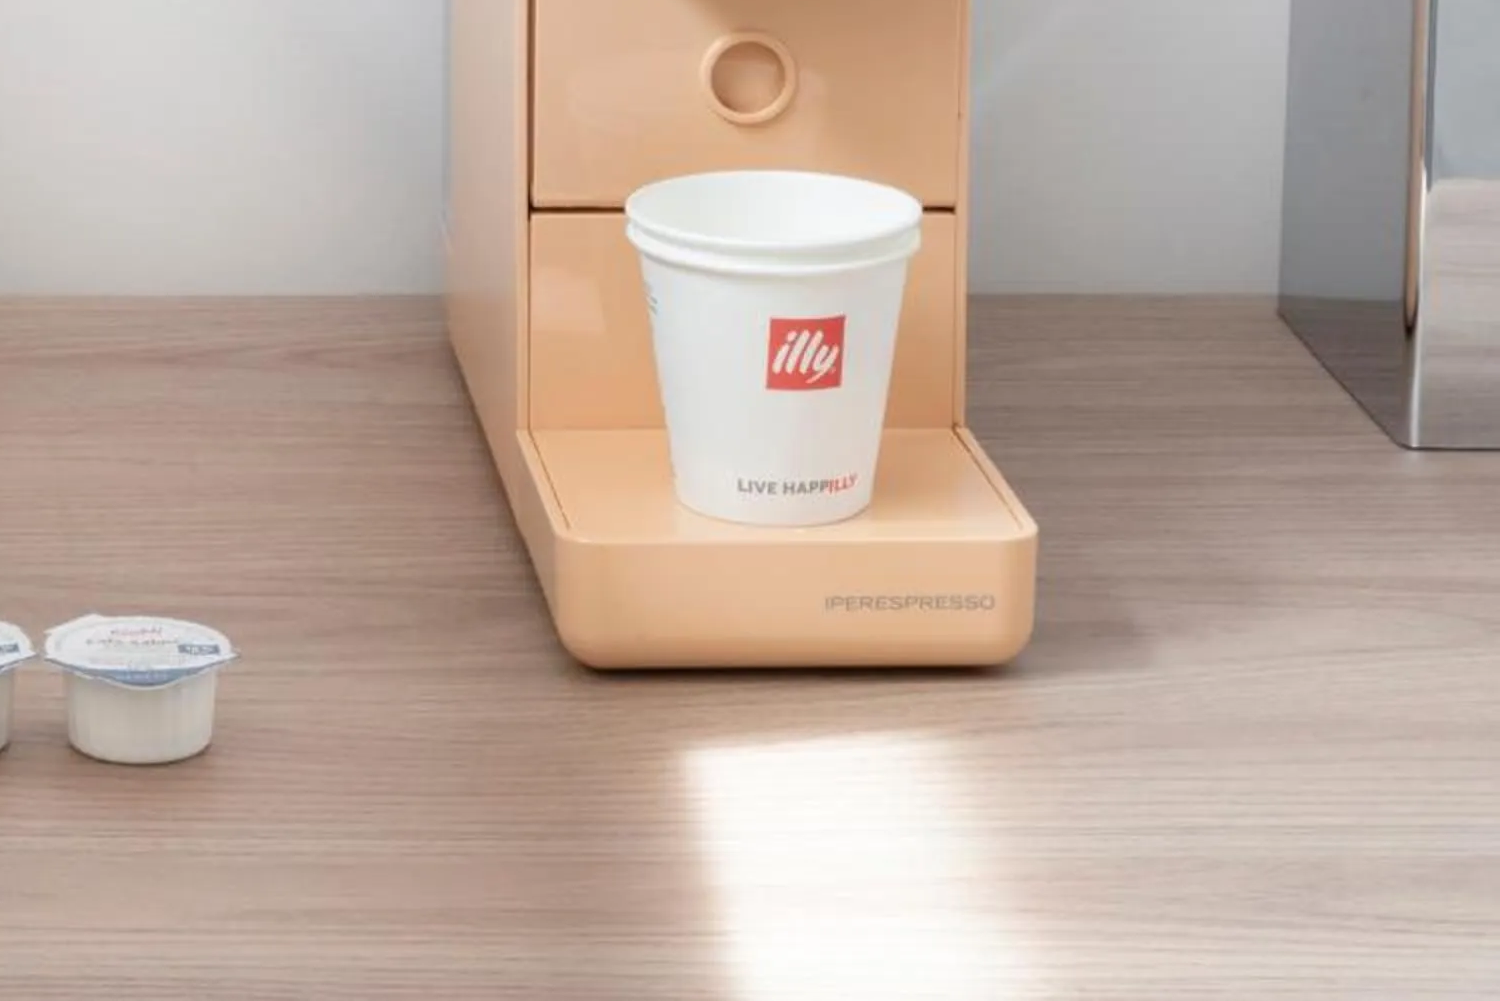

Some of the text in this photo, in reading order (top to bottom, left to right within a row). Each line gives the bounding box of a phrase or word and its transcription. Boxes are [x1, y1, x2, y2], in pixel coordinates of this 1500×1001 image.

[771, 329, 840, 385] illy
[737, 473, 858, 495] LIVE HAPPILLY
[824, 594, 996, 612] IPERESPRESSO
